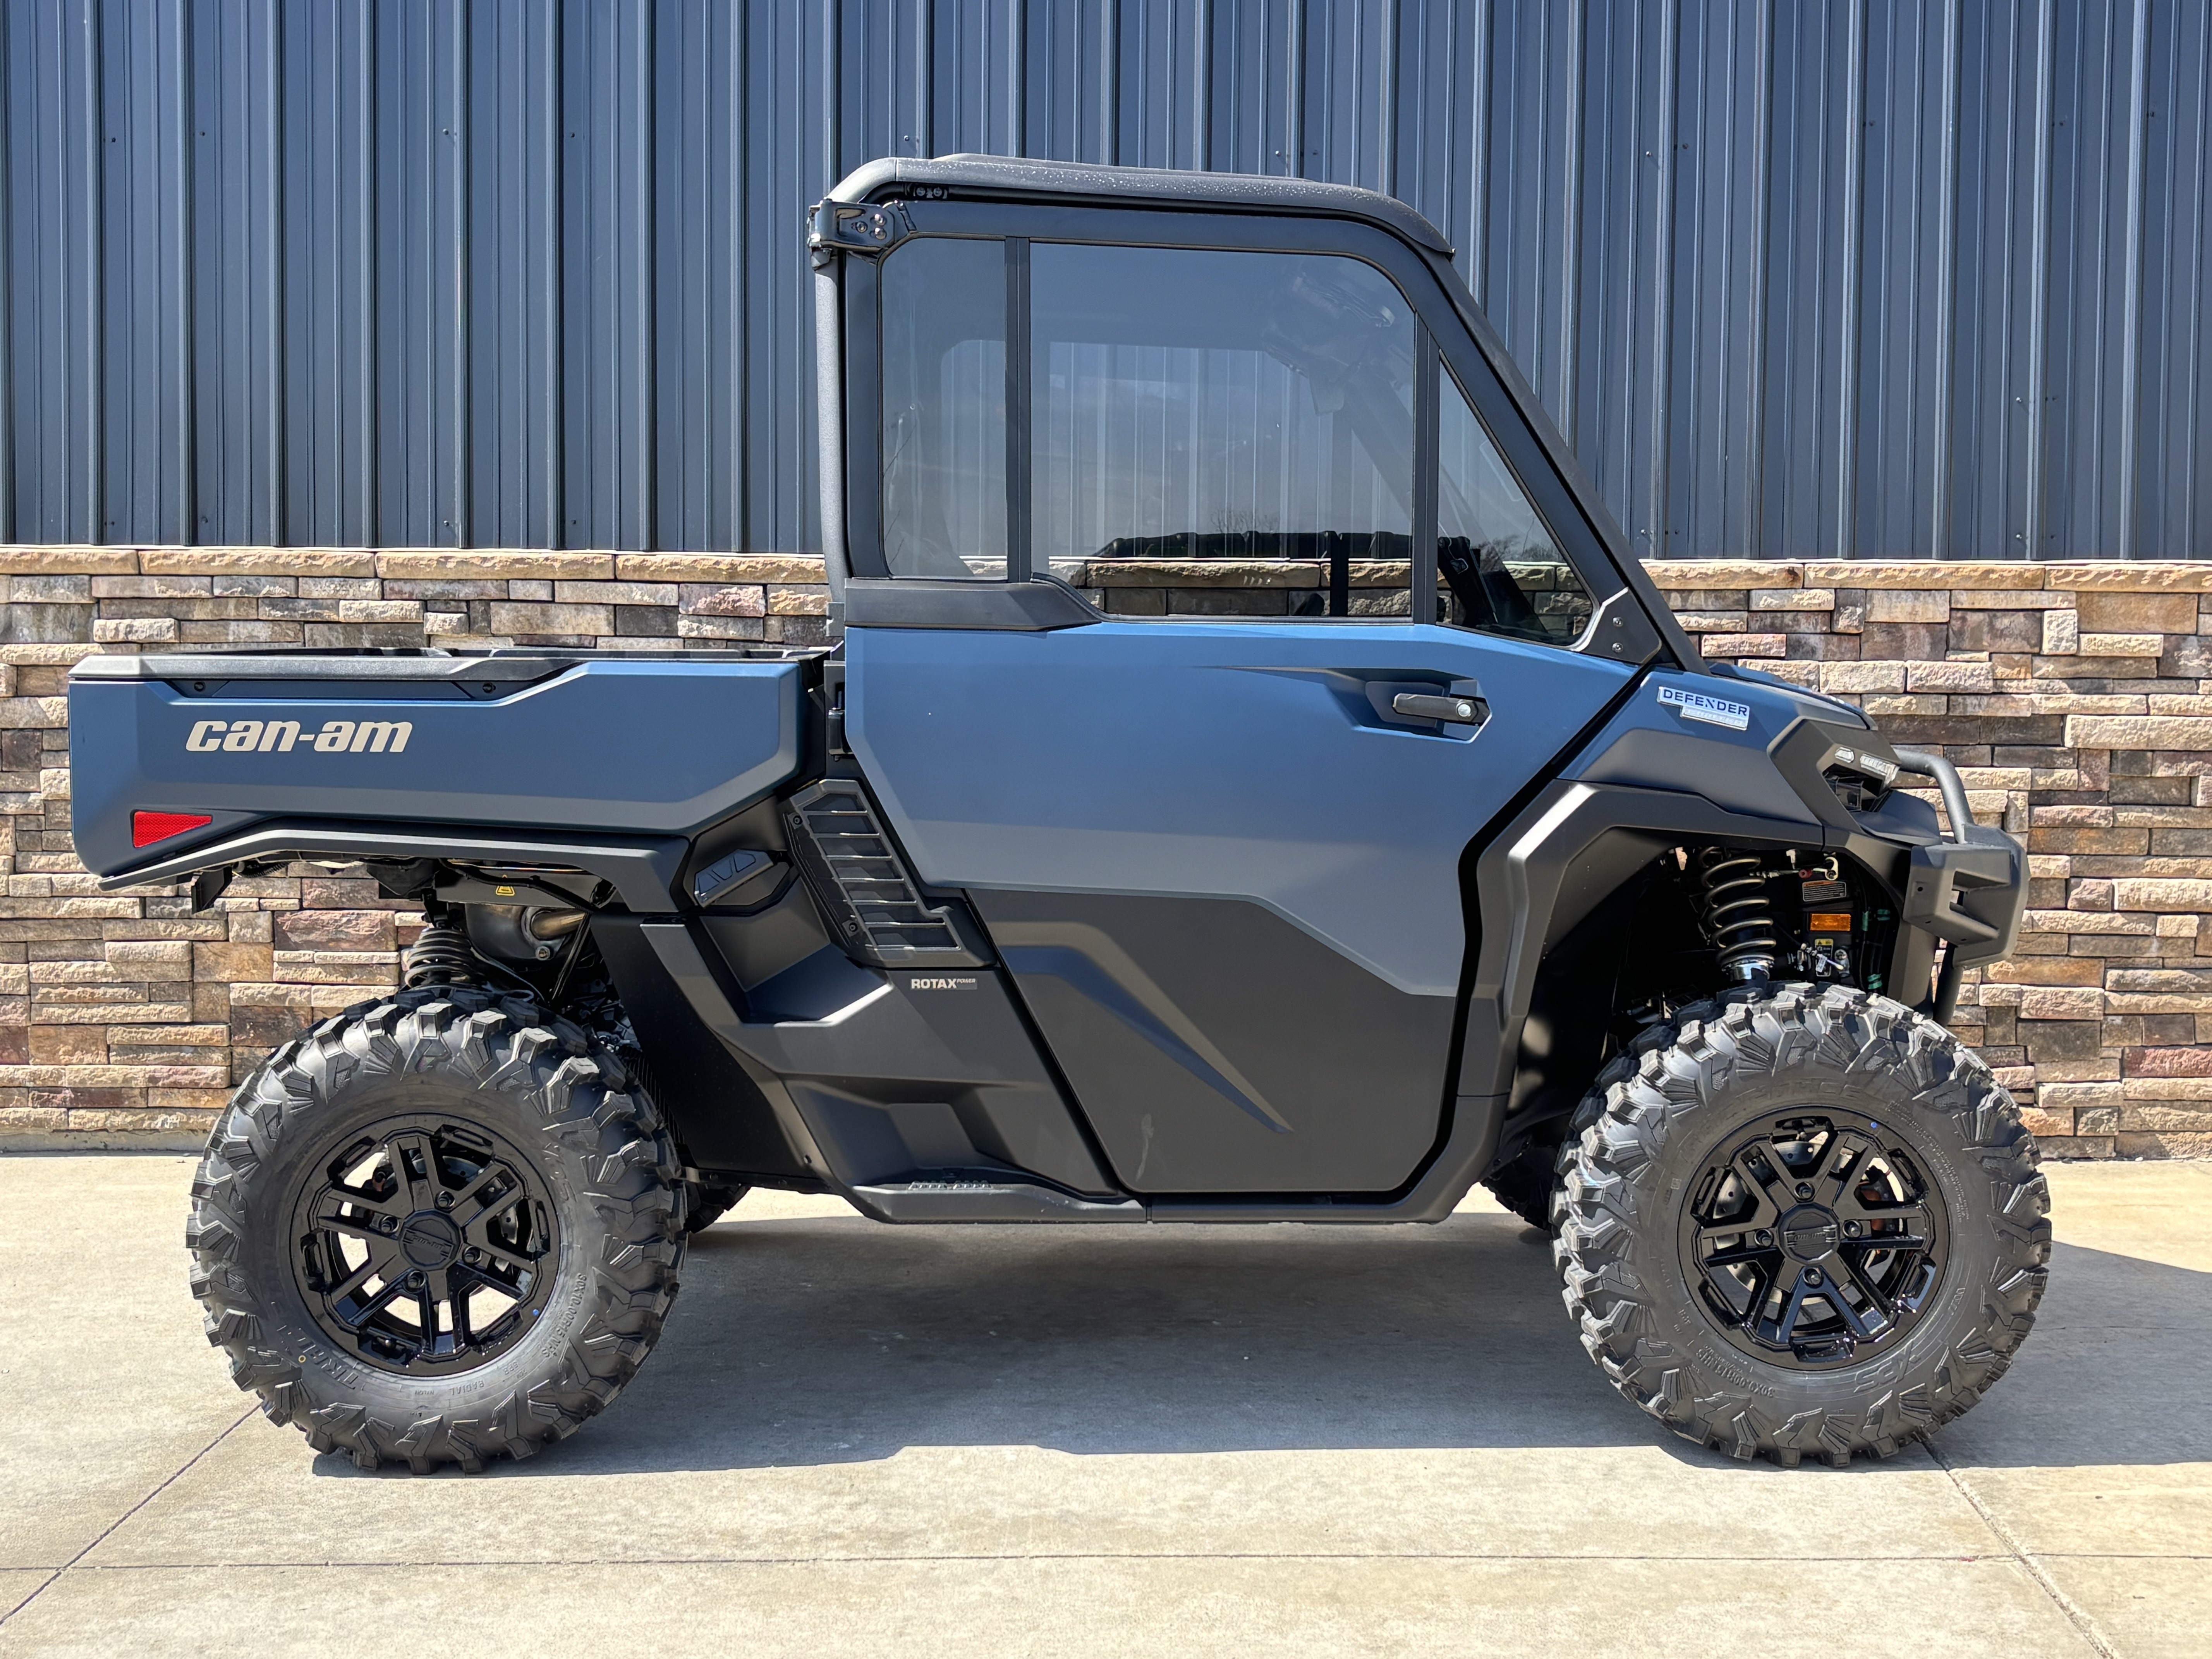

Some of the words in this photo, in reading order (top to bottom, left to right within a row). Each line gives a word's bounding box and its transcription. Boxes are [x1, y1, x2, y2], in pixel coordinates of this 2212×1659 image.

[1663, 689, 1747, 716] DEFENDER
[186, 720, 413, 752] can-am
[911, 979, 957, 989] ROTAX
